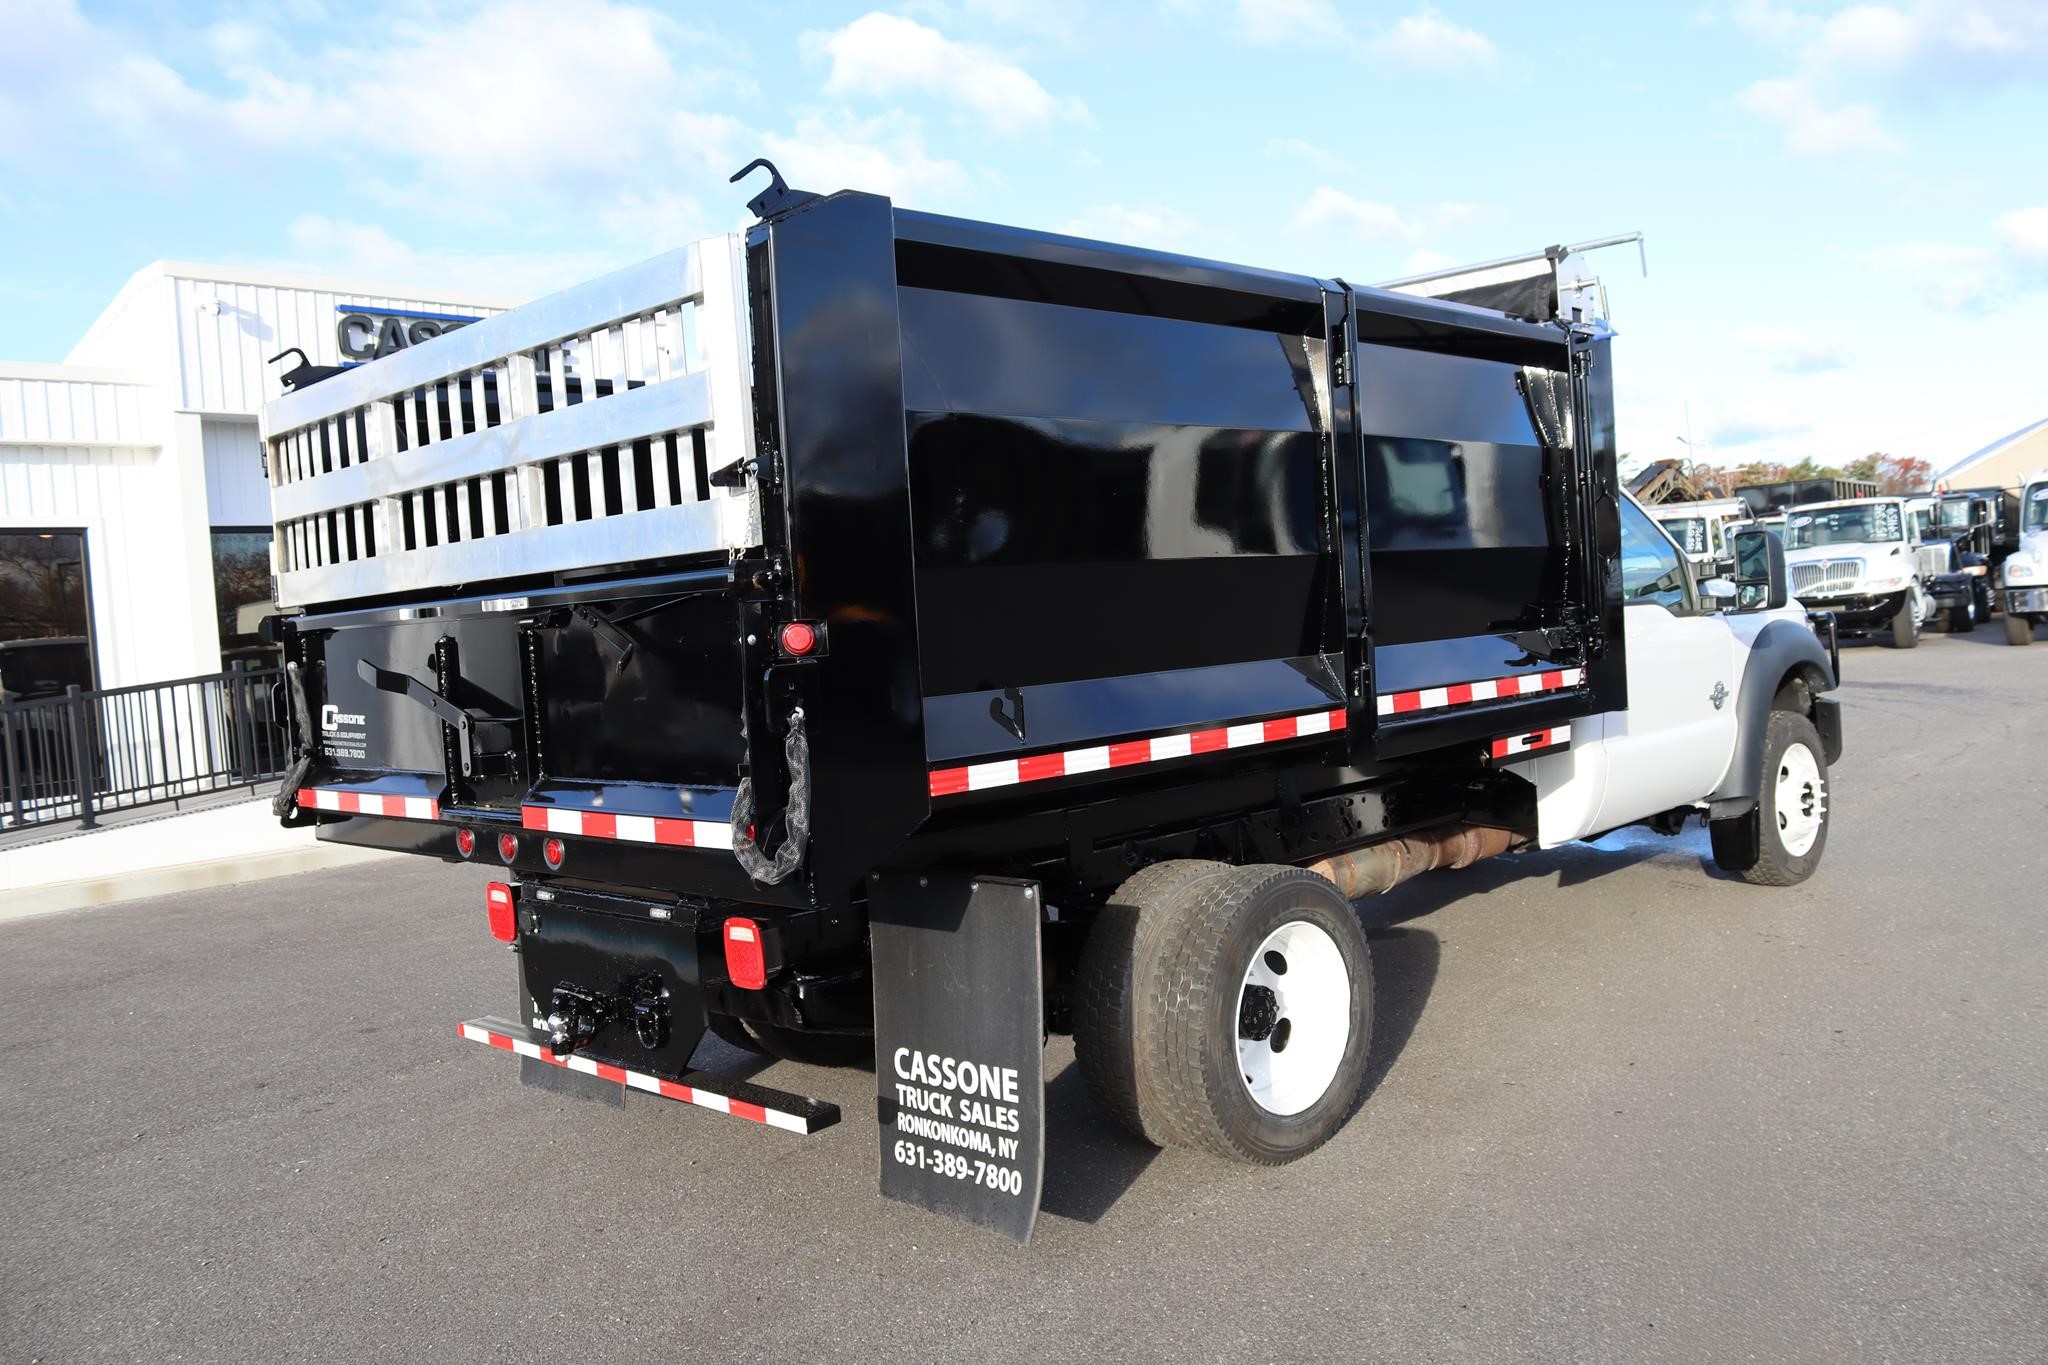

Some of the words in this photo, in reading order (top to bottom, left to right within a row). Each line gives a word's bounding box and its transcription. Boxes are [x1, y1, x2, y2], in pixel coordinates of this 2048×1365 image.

[894, 1047, 1019, 1104] CASSONE
[895, 1083, 954, 1119] TRUCK
[959, 1099, 1020, 1133] SALES
[897, 1112, 997, 1158] RONKONKOMA,
[998, 1136, 1019, 1160] NY
[894, 1140, 1023, 1196] 631-389-7800
